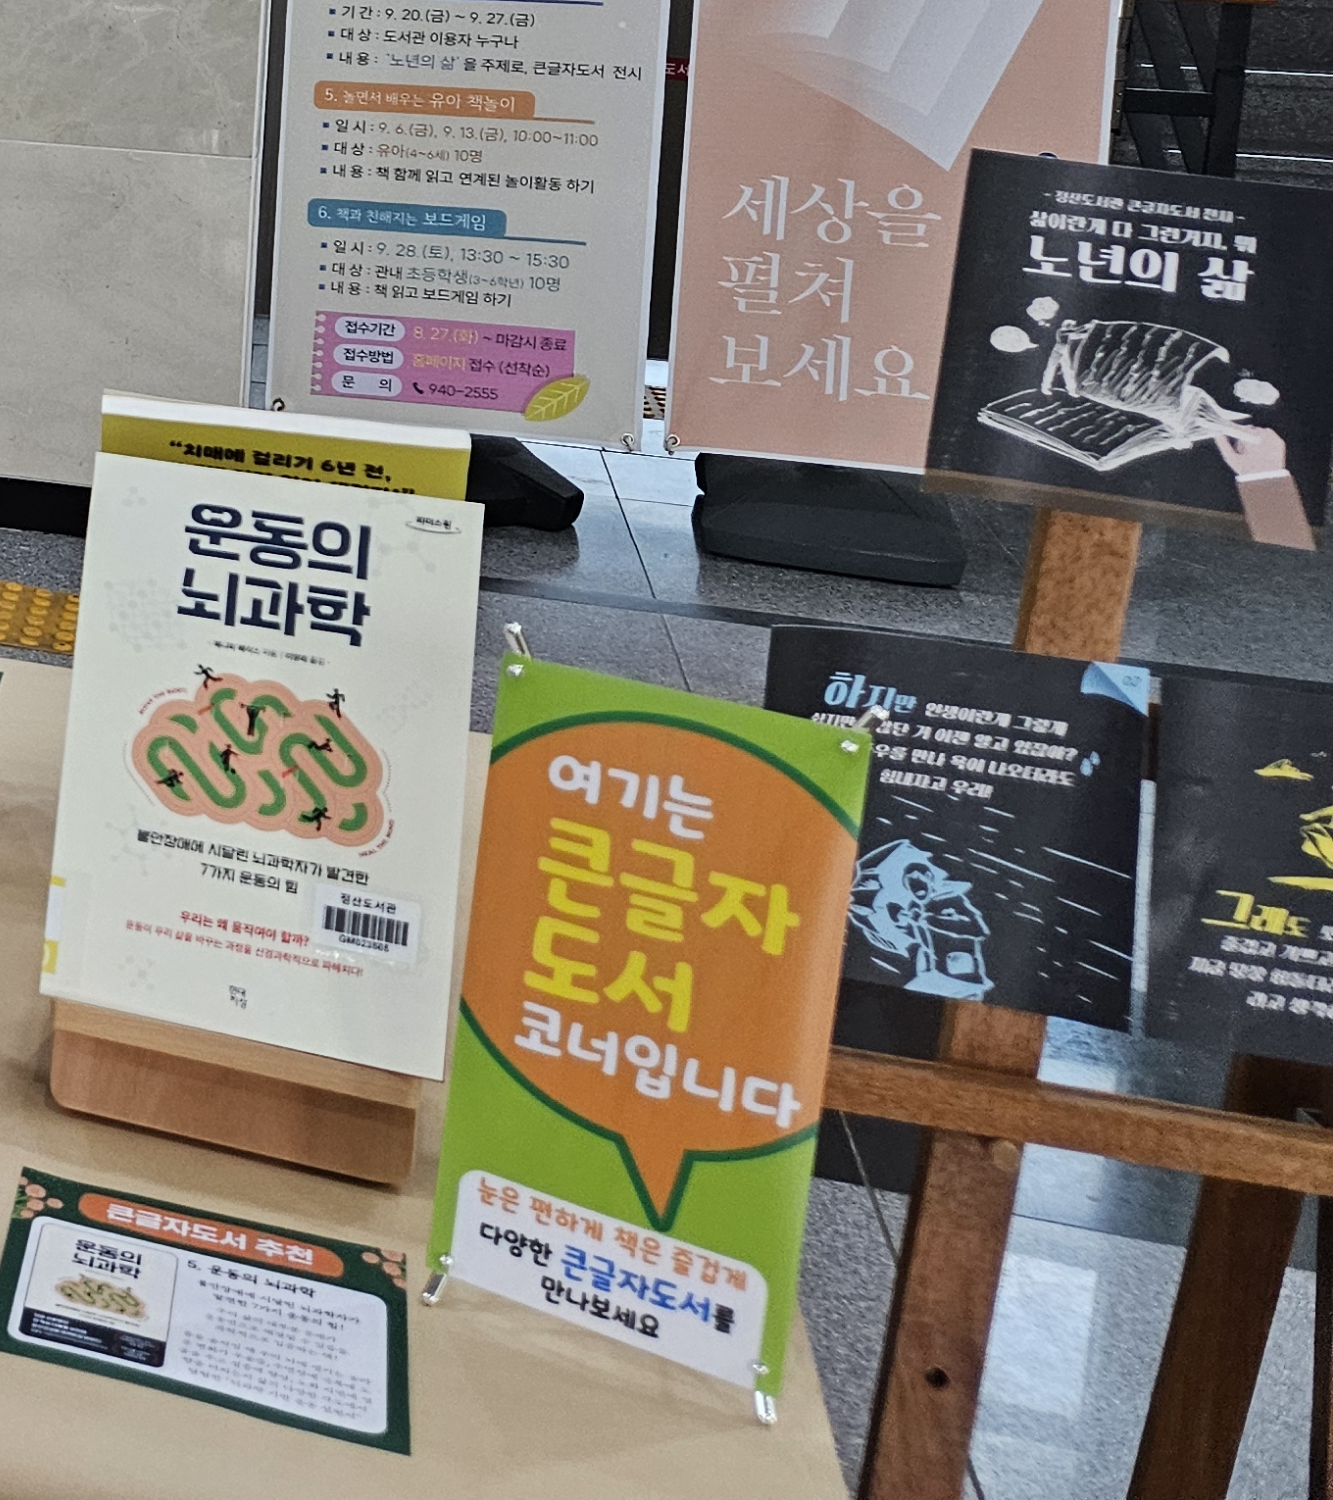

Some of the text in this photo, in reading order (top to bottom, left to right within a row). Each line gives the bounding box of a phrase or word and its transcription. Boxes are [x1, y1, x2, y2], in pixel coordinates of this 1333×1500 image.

[383, 31, 518, 48] 도서관 이용자 누구나
[424, 214, 486, 231] 보드게임
[722, 175, 941, 247] 세상을
[718, 251, 854, 323] 펼쳐
[1023, 235, 1255, 301] 노년의 삶
[345, 322, 395, 336] 접수기간
[429, 384, 499, 400] 940-2555
[709, 335, 930, 401] 보세요
[183, 502, 372, 581] 운동의
[177, 568, 371, 646] 뇌과학
[548, 755, 713, 840] 여기는
[341, 893, 397, 915] 정산도서관
[538, 817, 800, 956] 큰글자
[524, 916, 694, 1033] 도서
[515, 1002, 802, 1129] 코너입니다
[106, 1203, 313, 1266] 큰글자도서 추천
[476, 1176, 747, 1292] 눈은 편하게 책은 즐겁게
[478, 1222, 736, 1336] 다양한 큰글자도서를
[540, 1275, 659, 1339] 만나보세요
